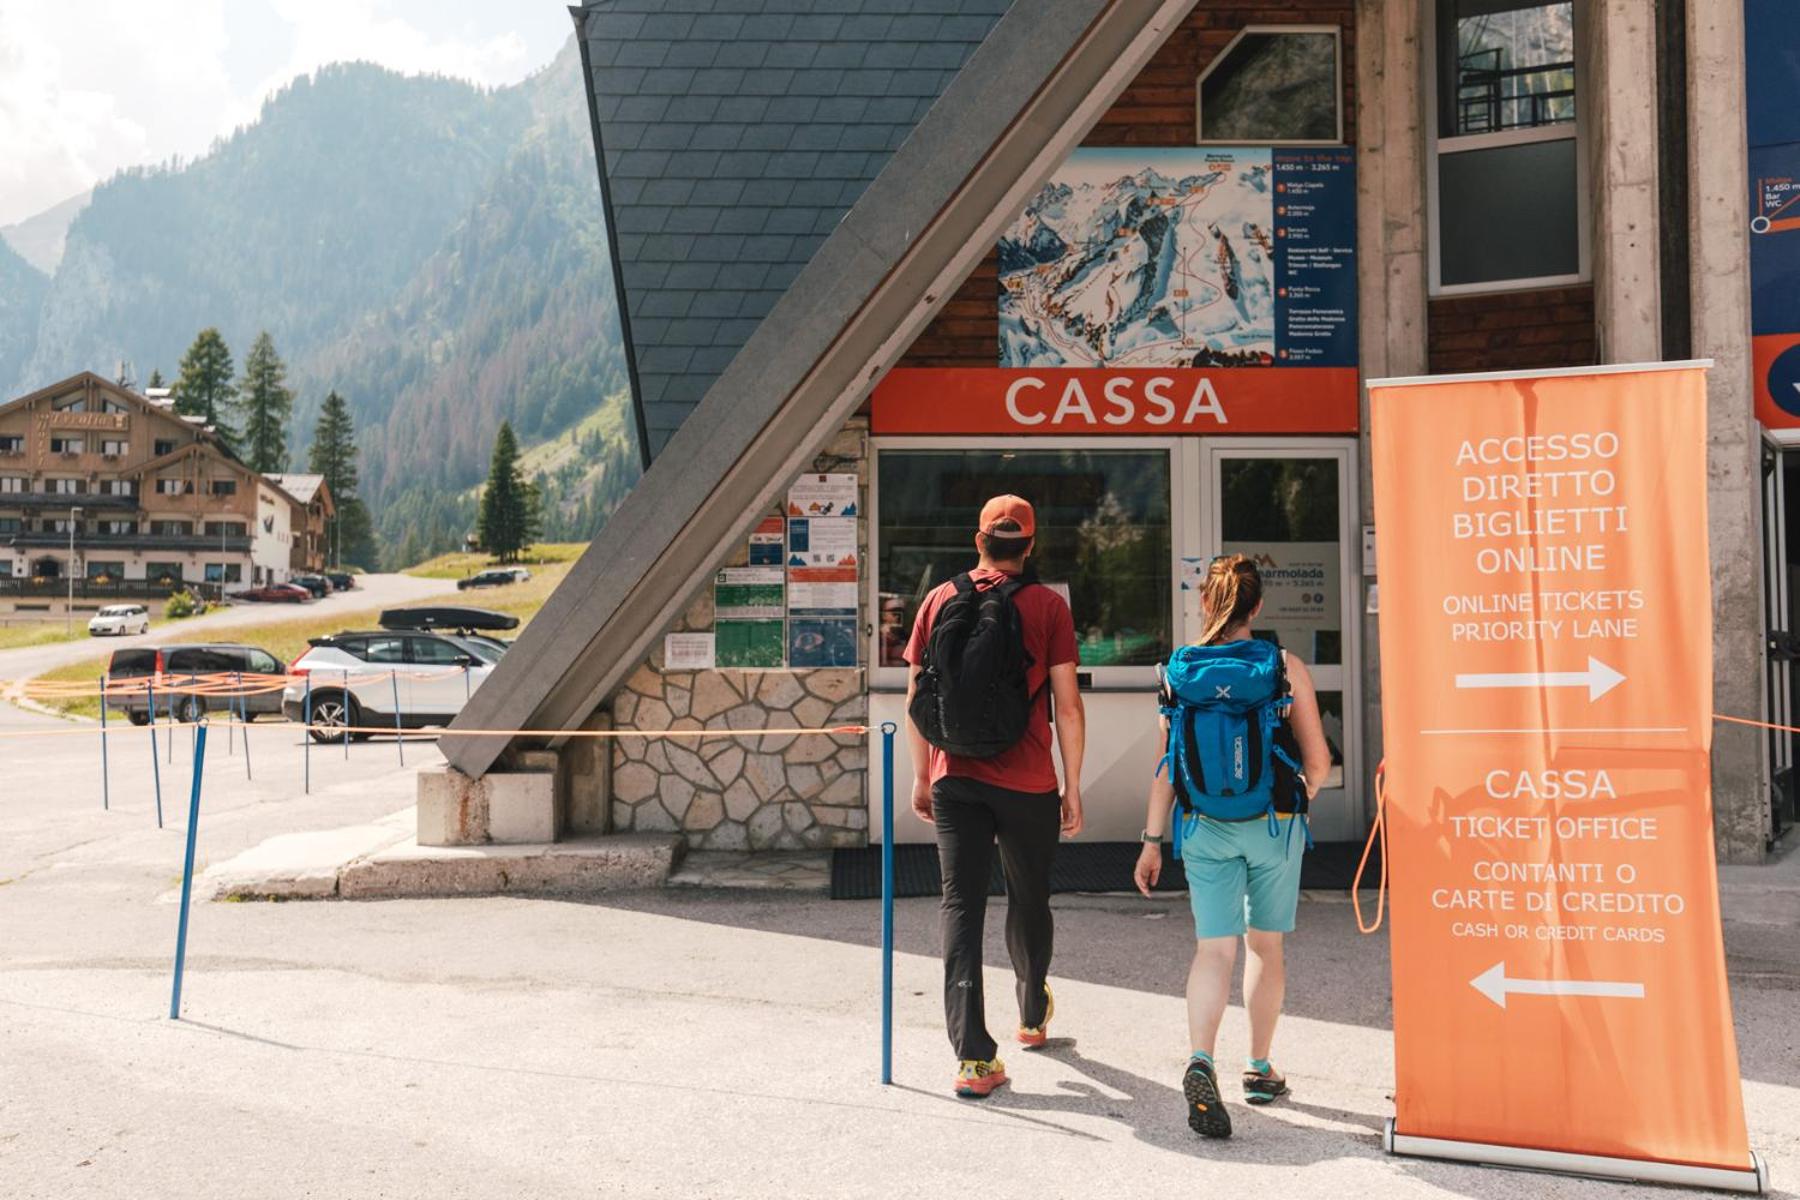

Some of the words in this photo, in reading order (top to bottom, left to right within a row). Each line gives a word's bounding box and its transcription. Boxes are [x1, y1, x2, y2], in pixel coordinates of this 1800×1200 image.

[1766, 183, 1790, 192] 1.450
[1005, 377, 1229, 425] CASSA
[1455, 432, 1620, 466] ACCESSO
[1463, 470, 1615, 502] DIRETTO
[1453, 506, 1628, 539] BIGLIETTI
[1476, 544, 1606, 574] ONLINE
[1443, 592, 1533, 615] ONLINE
[1540, 590, 1644, 611] TICKETS
[1452, 620, 1562, 641] PRIORITY
[1573, 619, 1638, 638] LANE
[1485, 769, 1616, 799] CASSA
[1450, 816, 1547, 840] TICKET
[1556, 817, 1657, 840] OFFICE
[1473, 862, 1603, 883] CONTANTI
[1615, 864, 1636, 883] O
[1432, 889, 1514, 911] CARTE
[1527, 892, 1552, 912] DI
[1562, 892, 1685, 915] CREDITO
[1452, 923, 1498, 937] CASH
[1505, 924, 1528, 938] OR
[1535, 925, 1596, 941] CREDIT
[1603, 926, 1665, 943] CARDS
